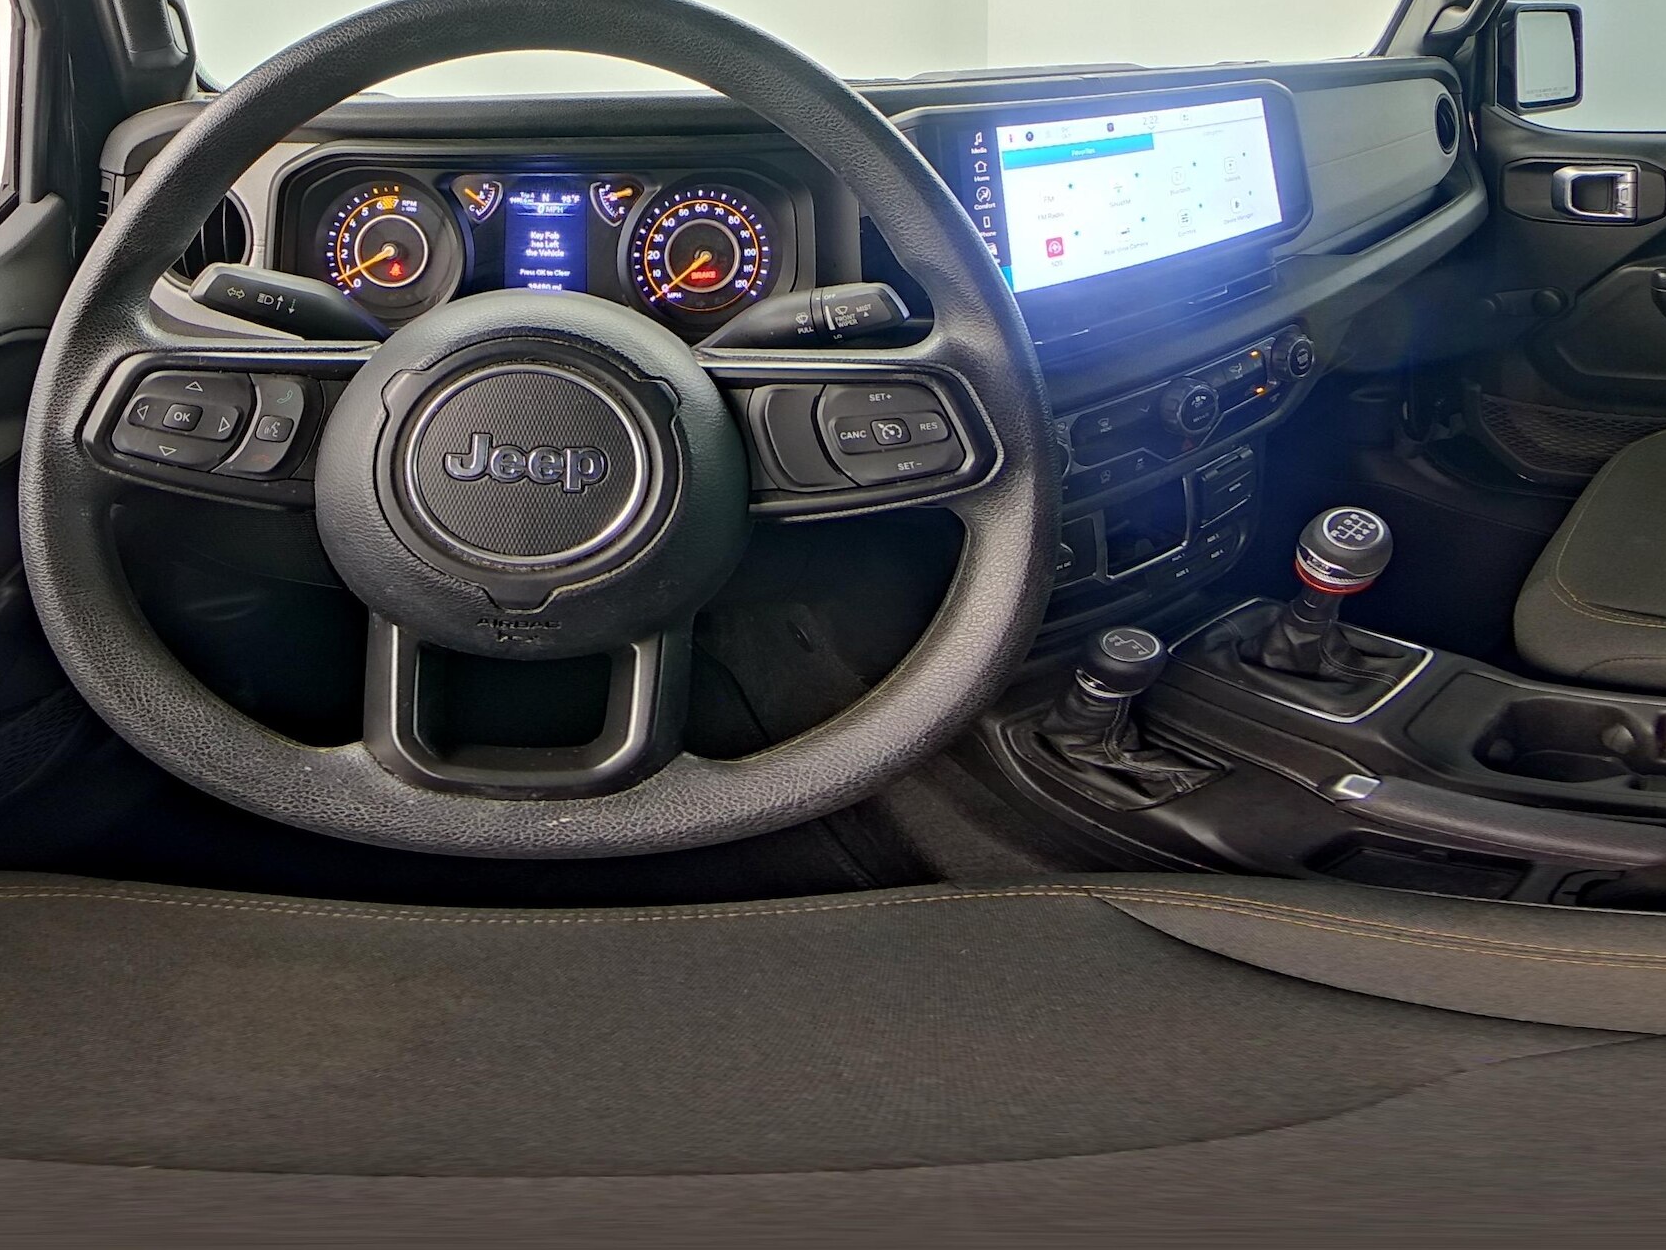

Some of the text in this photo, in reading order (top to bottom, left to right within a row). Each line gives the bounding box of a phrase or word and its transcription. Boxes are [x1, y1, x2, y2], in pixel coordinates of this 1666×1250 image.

[541, 193, 550, 202] N
[401, 199, 418, 207] RPM
[694, 203, 708, 212] 60
[974, 202, 996, 210] Comfort
[361, 206, 369, 216] 5
[678, 208, 689, 217] 50
[714, 207, 725, 216] 70
[349, 218, 356, 228] 4
[662, 218, 675, 227] 40
[727, 215, 741, 225] 80
[343, 233, 350, 243] 3
[530, 231, 560, 240] Key Fob
[653, 234, 664, 242] 30
[739, 230, 750, 238] 90
[531, 240, 560, 248] has Left
[341, 249, 349, 259] 2
[525, 249, 565, 257] the Vehicle
[647, 250, 661, 260] 20
[744, 249, 756, 257] 100
[652, 269, 662, 278] 10
[691, 271, 716, 280] BRAKE
[353, 278, 362, 288] 0
[735, 280, 748, 288] 120
[855, 303, 872, 313] MIST
[835, 313, 856, 322] FRONT
[837, 319, 859, 328] WIPER
[797, 326, 814, 335] PULL
[173, 411, 192, 423] OK
[919, 421, 938, 431] RES
[840, 430, 867, 440] CANC
[443, 432, 610, 494] Jeep
[476, 618, 562, 630] AIRBAG
